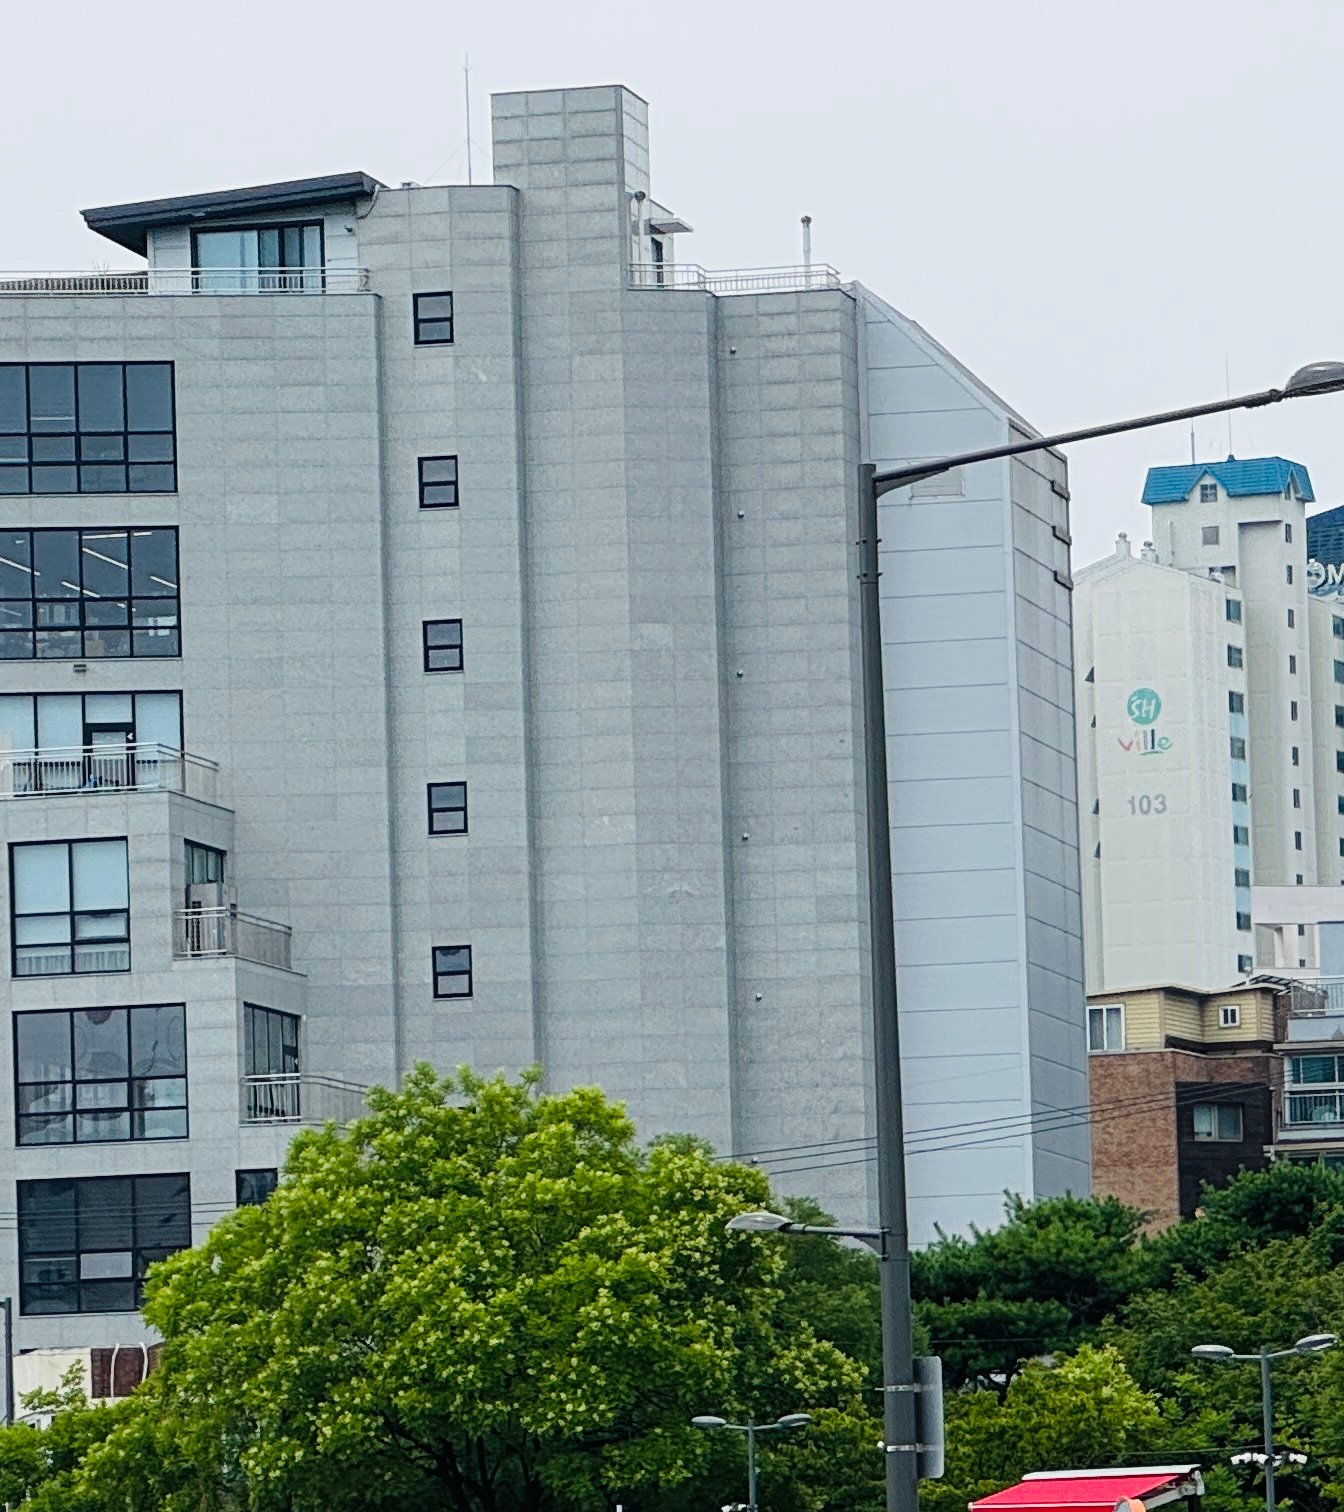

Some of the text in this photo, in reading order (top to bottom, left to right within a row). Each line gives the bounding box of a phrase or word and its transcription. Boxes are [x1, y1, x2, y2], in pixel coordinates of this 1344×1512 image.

[1130, 696, 1157, 719] SH
[1117, 728, 1173, 752] ville
[1127, 793, 1167, 816] 103
